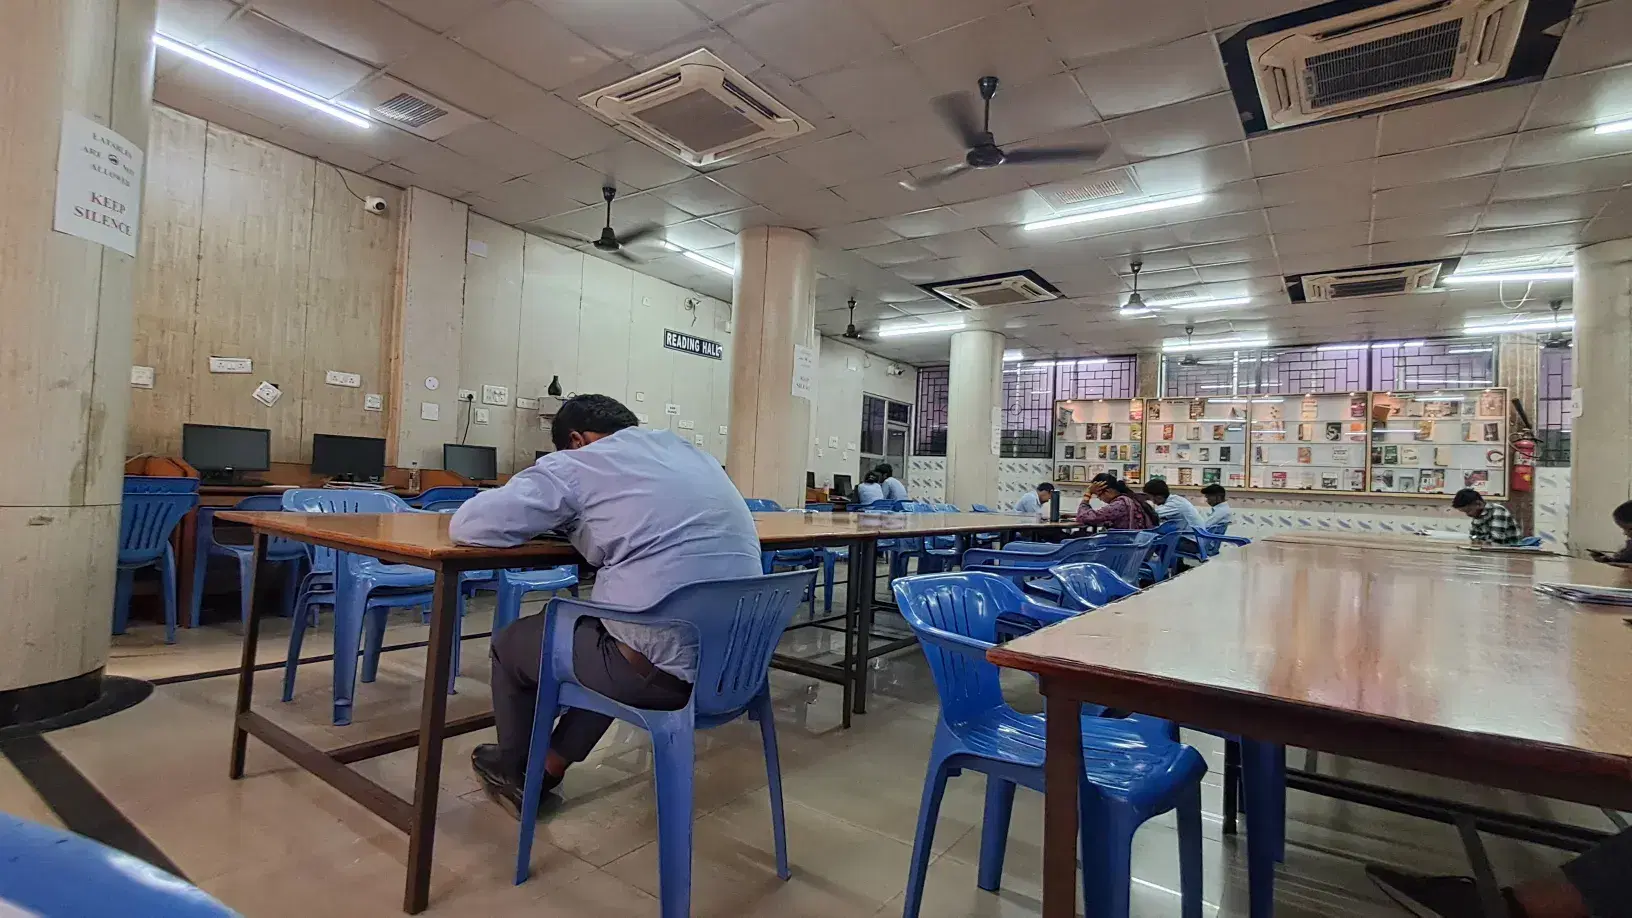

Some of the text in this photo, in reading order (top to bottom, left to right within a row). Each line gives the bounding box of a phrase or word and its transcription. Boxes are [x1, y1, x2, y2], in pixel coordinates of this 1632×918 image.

[80, 145, 102, 159] ARE
[90, 191, 126, 215] KEEP
[73, 205, 132, 237] SILENCE
[666, 332, 720, 357] READING HALL
